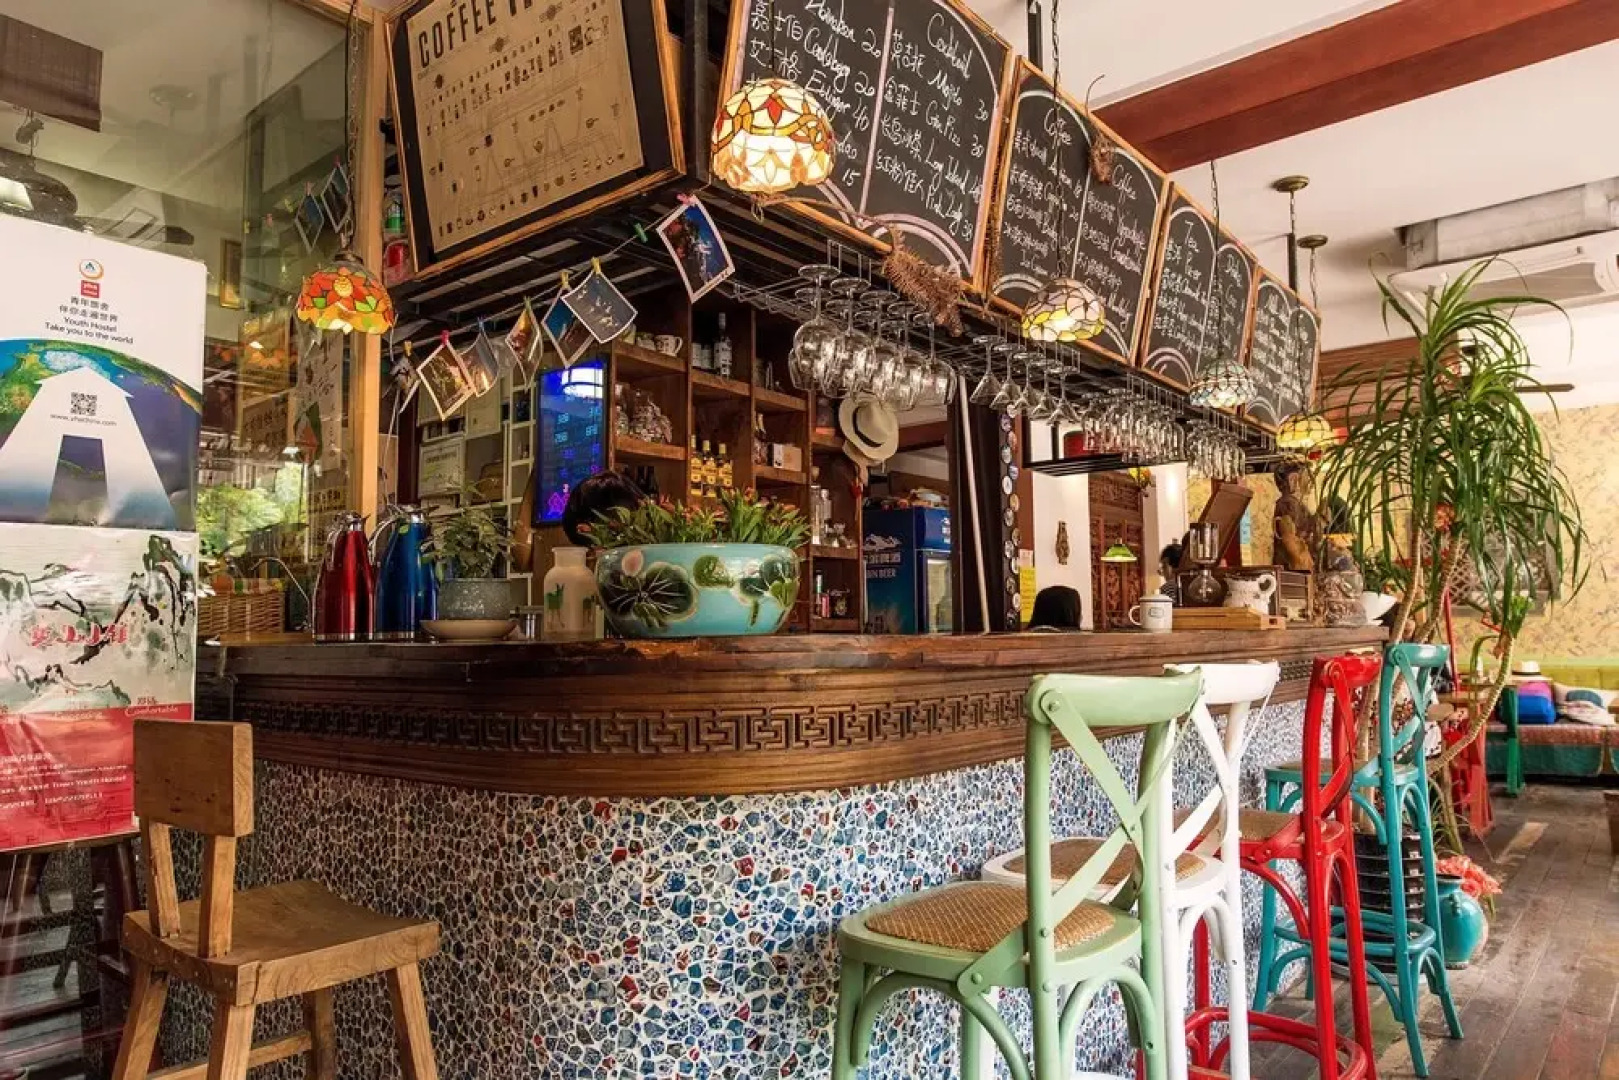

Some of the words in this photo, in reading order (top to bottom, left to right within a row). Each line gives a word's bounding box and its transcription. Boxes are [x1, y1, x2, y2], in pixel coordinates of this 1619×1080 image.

[419, 0, 497, 68] COFFEE
[842, 168, 861, 187] 15
[45, 322, 65, 332] Take
[66, 326, 83, 335] you
[95, 332, 109, 340] the
[110, 335, 134, 344] world
[64, 317, 89, 328] Youth
[90, 322, 117, 332] Hostel
